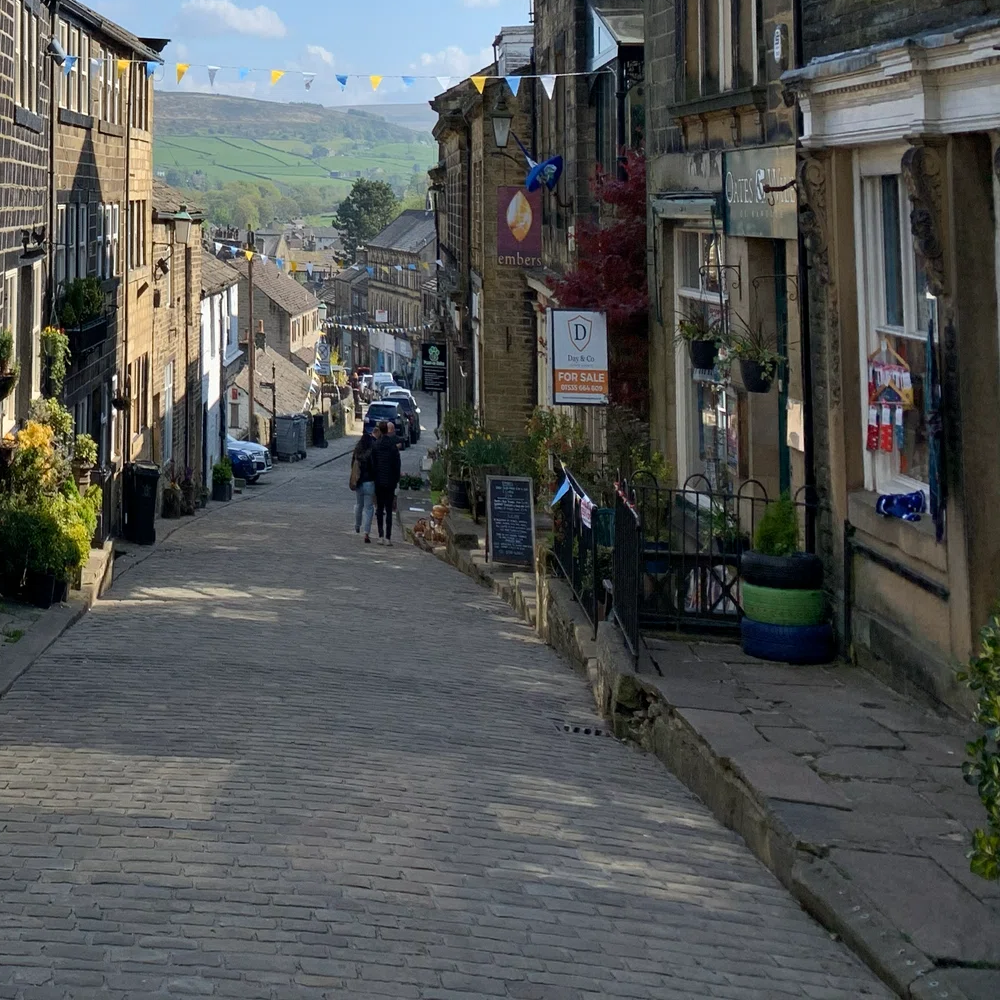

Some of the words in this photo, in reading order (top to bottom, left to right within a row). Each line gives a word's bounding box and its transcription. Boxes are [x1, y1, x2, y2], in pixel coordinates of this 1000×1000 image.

[498, 251, 542, 266] embers
[574, 323, 587, 341] D
[586, 355, 595, 363] Co
[558, 372, 578, 382] FOR
[580, 373, 605, 382] SALE
